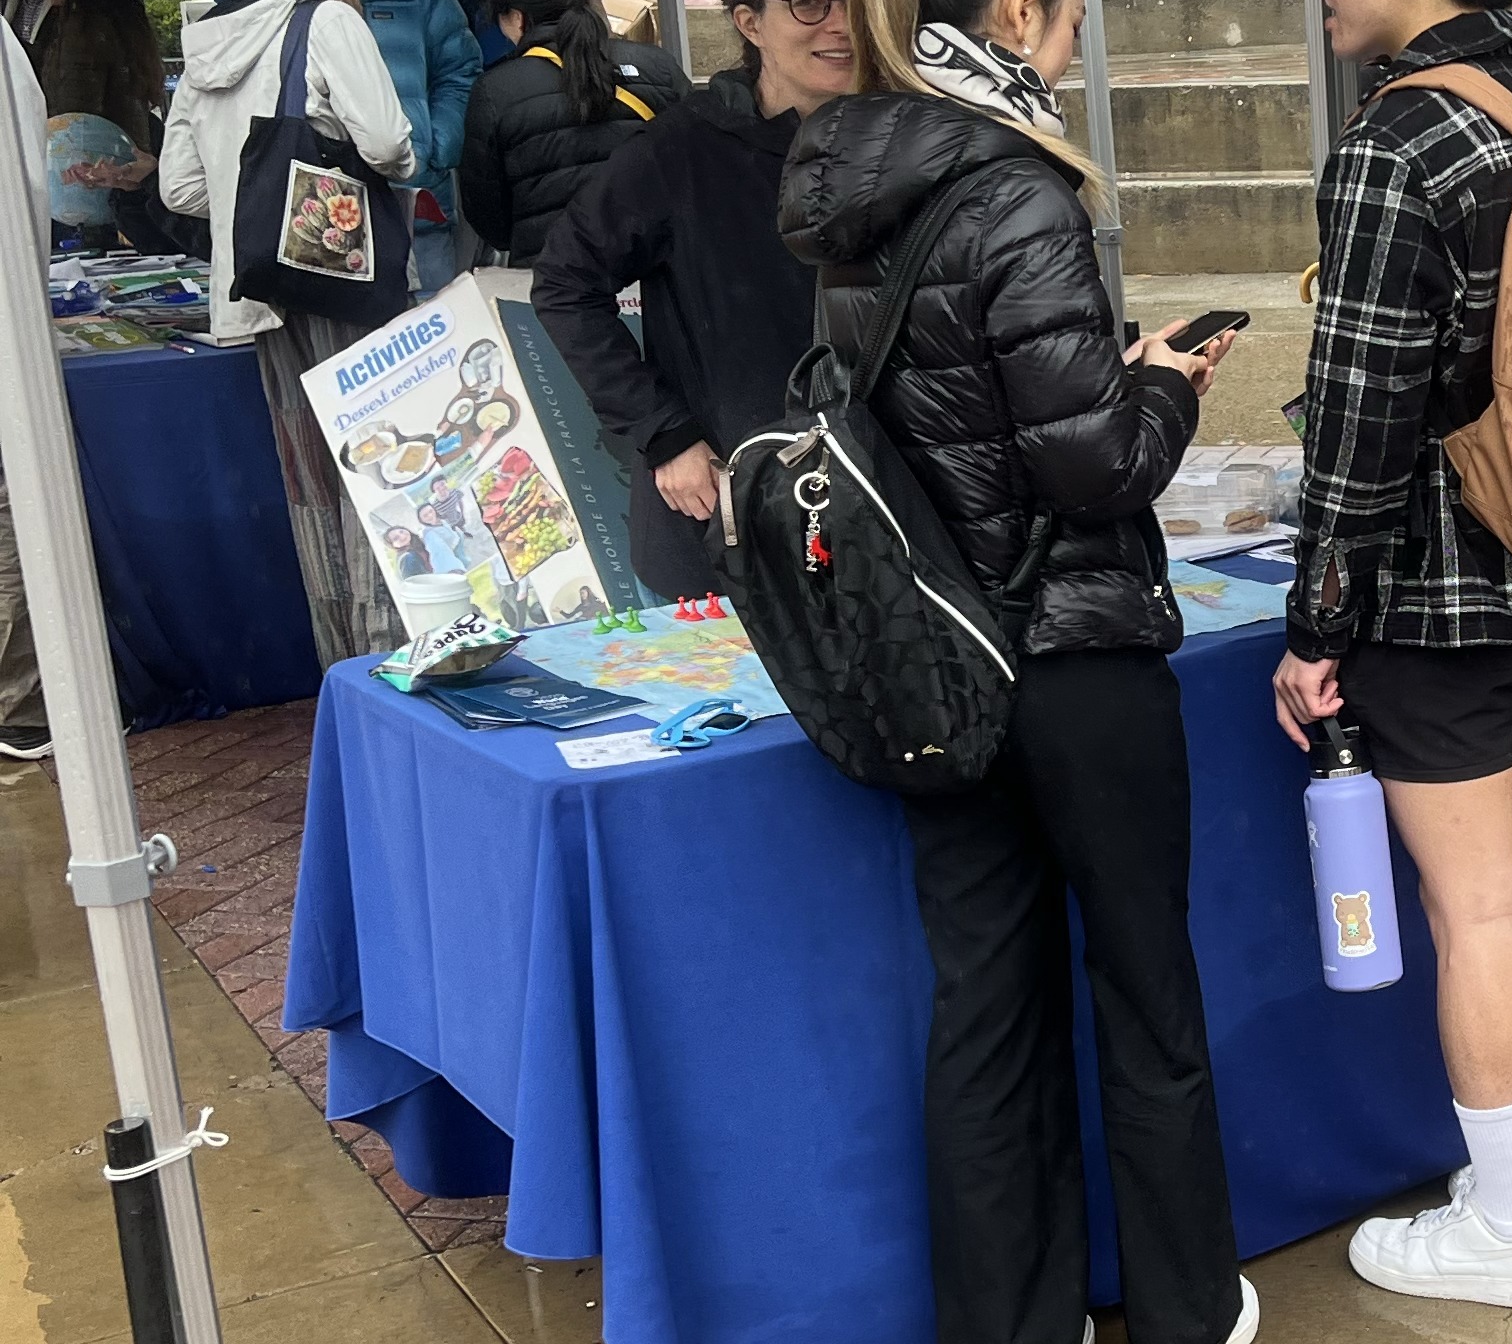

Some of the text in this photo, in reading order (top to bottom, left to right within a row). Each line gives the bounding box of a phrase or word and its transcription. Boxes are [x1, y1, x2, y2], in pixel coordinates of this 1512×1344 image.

[334, 347, 457, 431] Dessert workshop
[335, 313, 447, 396] Activities
[517, 323, 634, 600] LE MONDE DE LA FRANCOPHONIE
